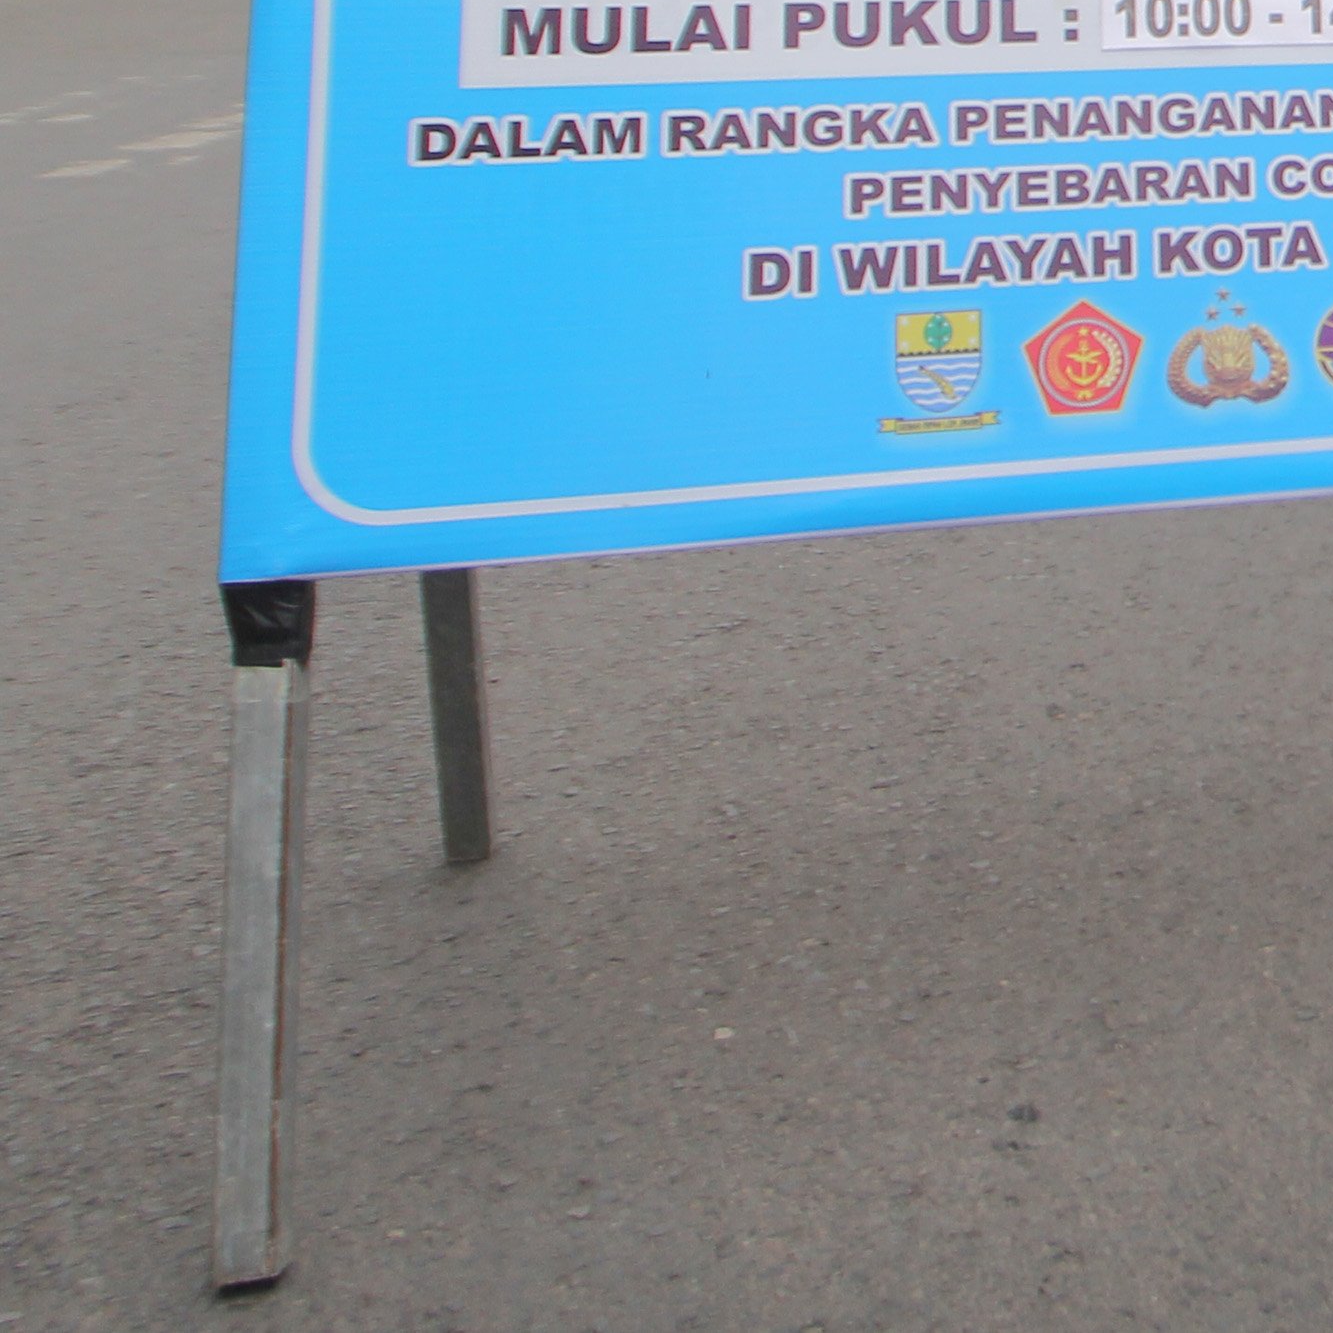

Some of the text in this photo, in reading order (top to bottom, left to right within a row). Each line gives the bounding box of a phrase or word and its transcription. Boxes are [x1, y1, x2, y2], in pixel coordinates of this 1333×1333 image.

[500, 2, 751, 56] MULAI
[414, 116, 643, 162] DALAM
[666, 106, 934, 153] RANGKA
[848, 161, 1252, 215] PENYEBARAN
[747, 248, 813, 297] DI
[839, 233, 1133, 292] WILAYAH
[1156, 226, 1324, 275] KOTA
